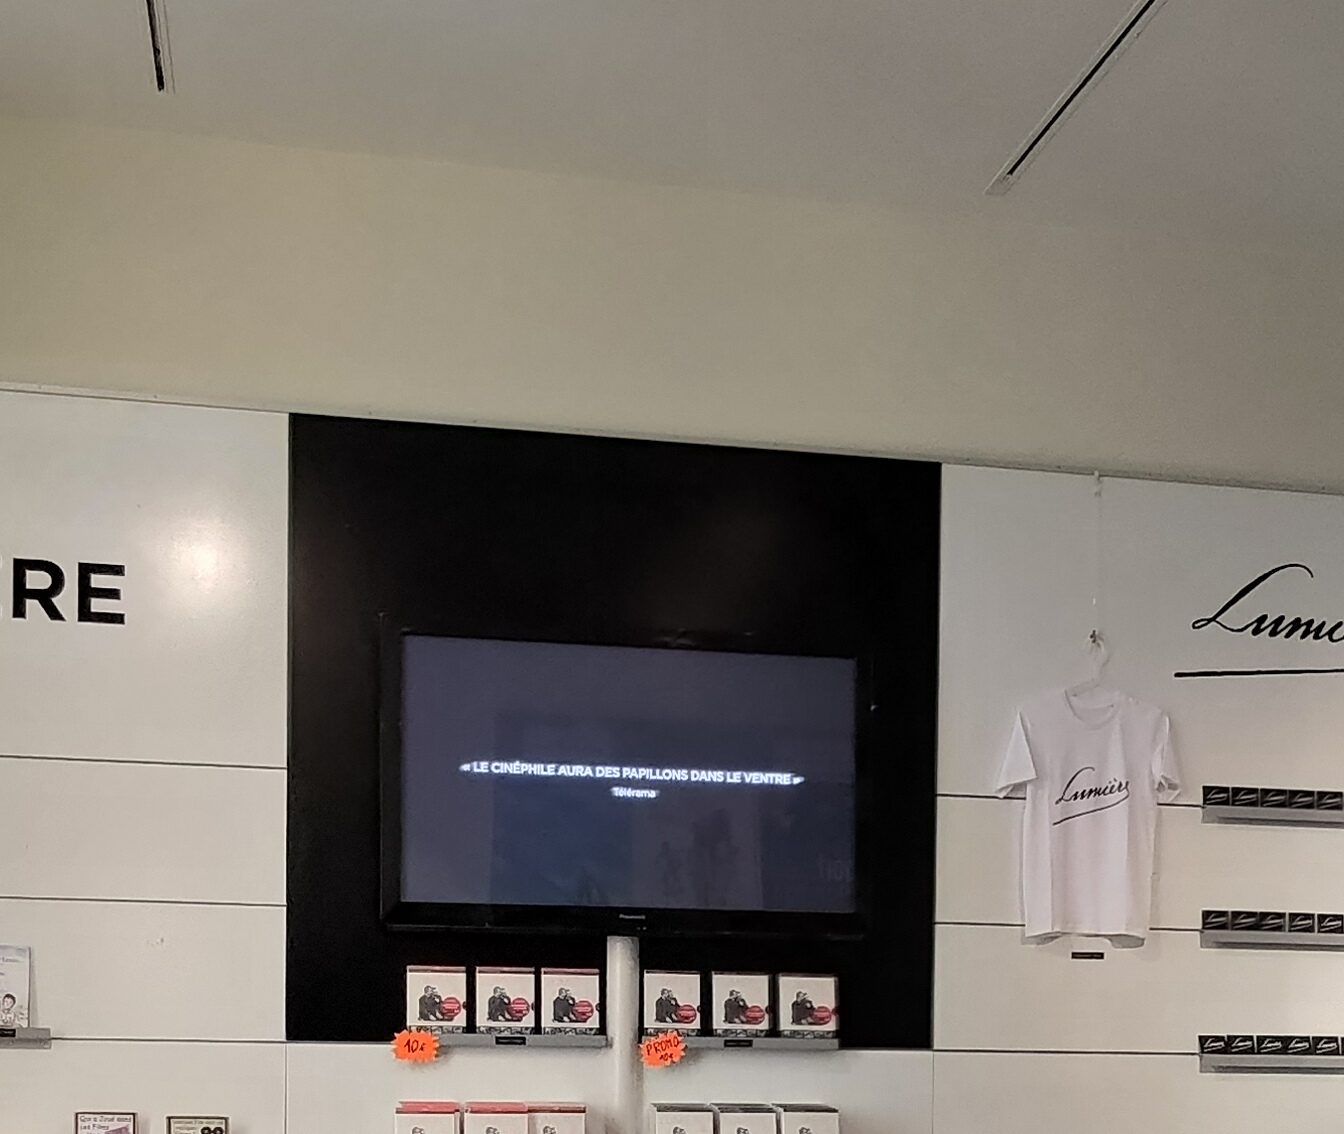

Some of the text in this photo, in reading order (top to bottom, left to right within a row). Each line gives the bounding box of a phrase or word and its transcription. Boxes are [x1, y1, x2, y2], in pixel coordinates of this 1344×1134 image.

[472, 761, 489, 773] LE
[490, 760, 556, 776] CINÉPHILE
[557, 765, 594, 777] AURA
[595, 766, 621, 778] DES
[622, 767, 688, 781] PAPILLONS
[690, 770, 724, 783] DANS
[726, 771, 742, 783] LE
[743, 773, 791, 785] VENTRE
